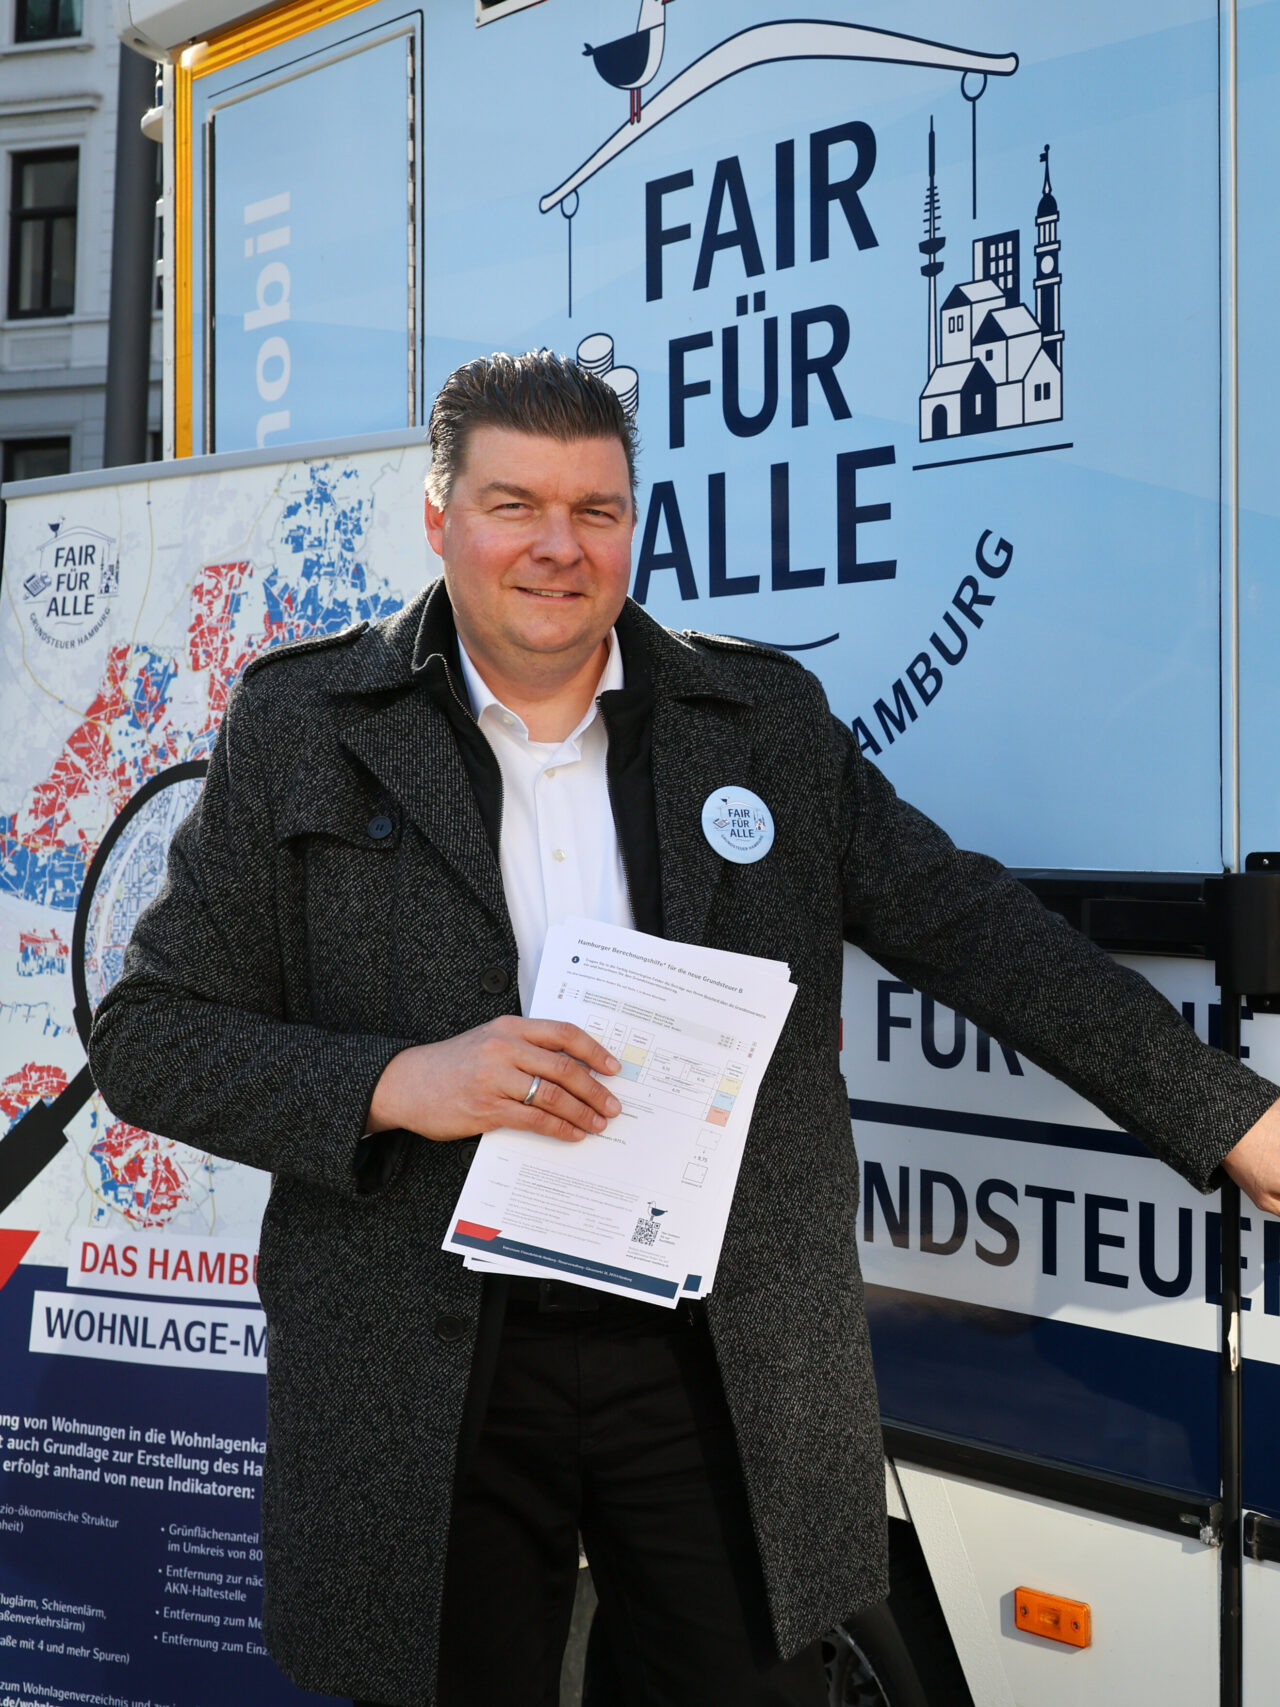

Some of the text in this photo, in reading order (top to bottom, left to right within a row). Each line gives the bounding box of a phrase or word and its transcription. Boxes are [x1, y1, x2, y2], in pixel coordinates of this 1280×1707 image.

[645, 120, 879, 302] FAIR
[668, 290, 852, 449] FÜR
[634, 445, 898, 605] ALLE
[54, 544, 96, 568] FAIR
[56, 568, 90, 592] FÜR
[46, 594, 95, 617] ALLE
[30, 607, 111, 649] GRUNDSTEUER HAMBURG
[851, 528, 1014, 756] AMBURG
[728, 808, 751, 818] FAIR
[731, 817, 750, 828] FÜR
[729, 828, 755, 838] ALLE
[80, 1241, 258, 1286] DAS HAMB
[45, 1306, 267, 1359] WOHNLAGE-M
[23, 1416, 48, 1430] von
[51, 1415, 126, 1442] Wohnungen
[128, 1425, 142, 1442] in
[144, 1427, 167, 1445] die
[170, 1429, 266, 1454] Wohnlagenka
[7, 1436, 39, 1452] auch
[43, 1438, 110, 1463] Grundlage
[112, 1449, 134, 1464] zur
[137, 1449, 209, 1475] Erstellung
[213, 1457, 240, 1474] des
[243, 1459, 264, 1477] Ha
[2, 1458, 256, 1500] erfolgt anhand von neun Indikatoren:
[81, 1512, 119, 1529] Struktur
[168, 1523, 260, 1545] Grünflächenanteil
[166, 1540, 263, 1561] im Umkreis von 80
[166, 1564, 223, 1586] Entfernung
[225, 1574, 243, 1584] zur
[164, 1581, 247, 1603] AKN-Haltestelle
[41, 1598, 107, 1620] Schienenlärm,
[163, 1606, 221, 1628] Entfernung
[222, 1616, 246, 1628] zum
[19, 1637, 35, 1651] mit
[37, 1640, 44, 1652] 4
[46, 1643, 64, 1655] und
[66, 1645, 91, 1658] mehr
[93, 1647, 130, 1665] Spuren)
[161, 1631, 219, 1652] Entfernung
[221, 1641, 244, 1653] zum
[0, 1681, 20, 1692] zum
[22, 1681, 129, 1707] Wohnlagenverzeichnis
